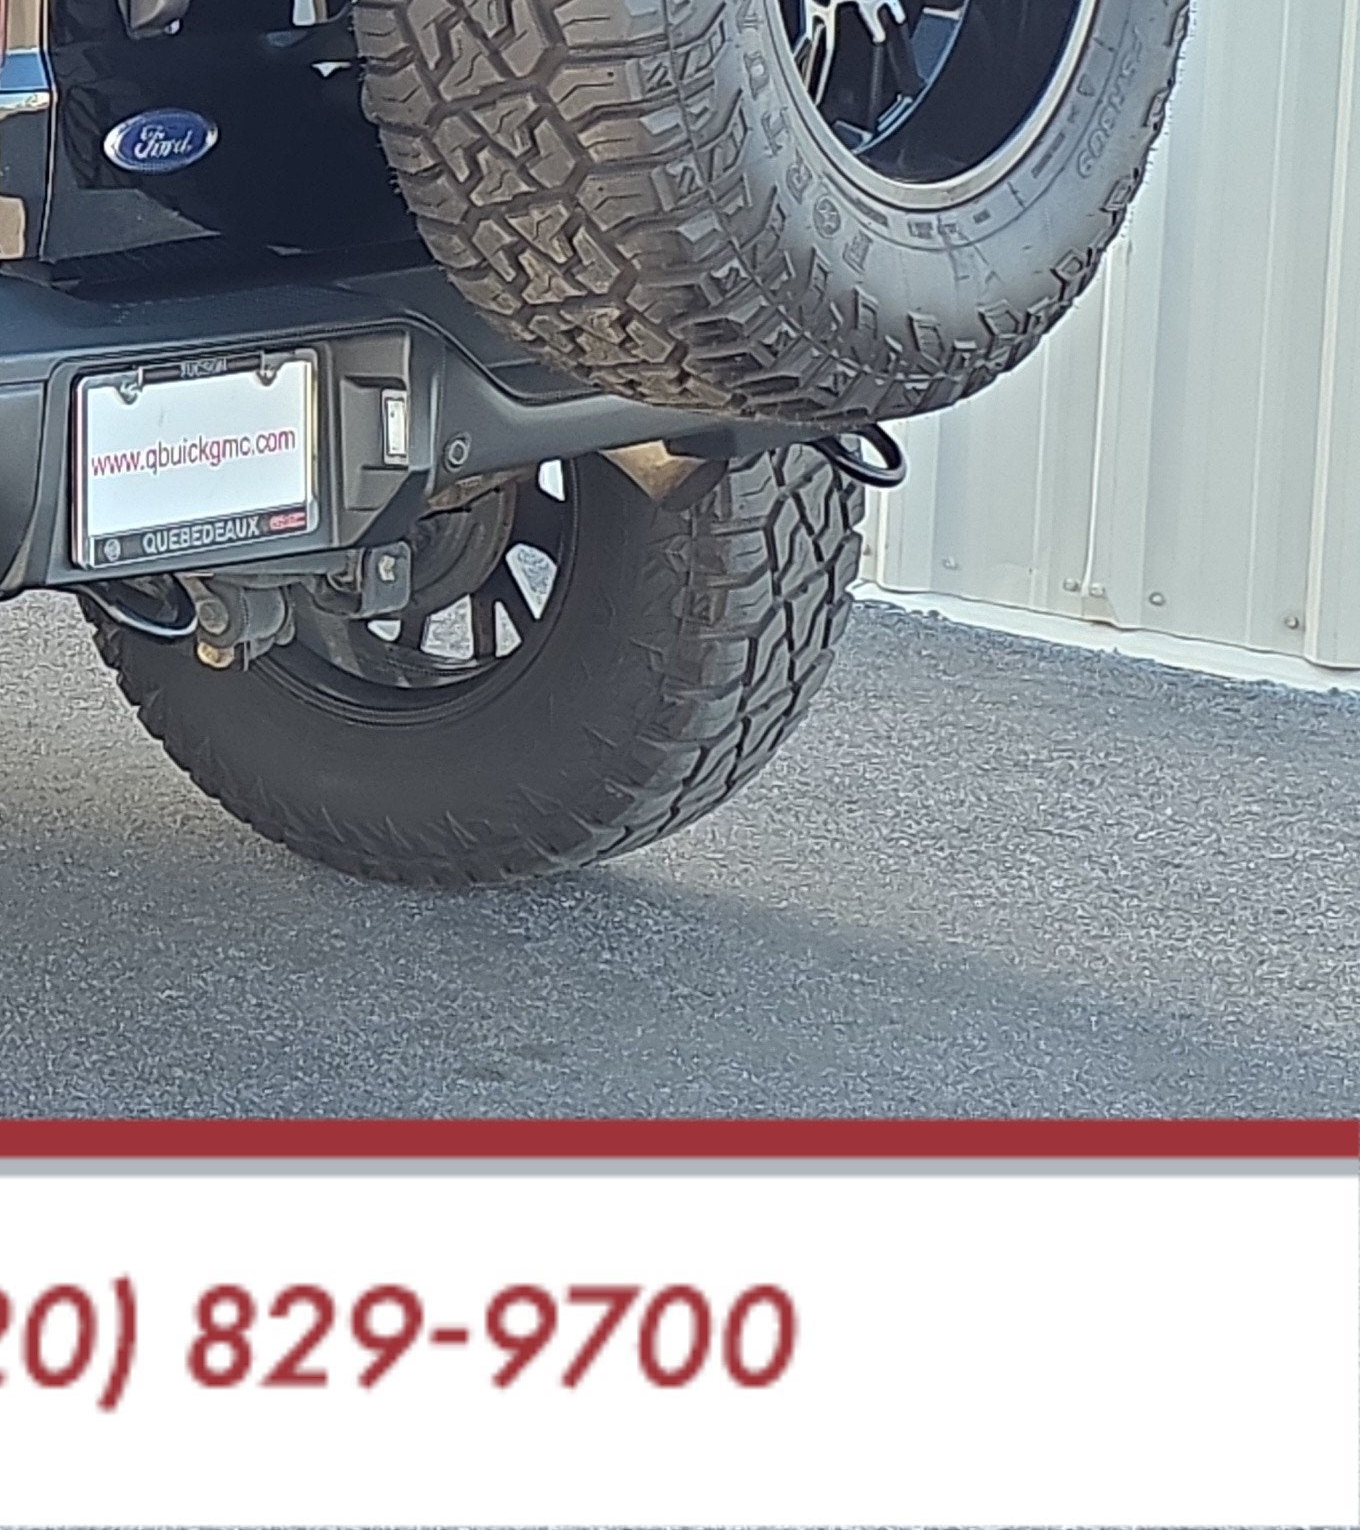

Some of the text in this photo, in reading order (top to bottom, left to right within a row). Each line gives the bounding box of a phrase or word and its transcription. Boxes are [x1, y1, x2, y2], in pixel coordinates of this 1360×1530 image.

[134, 124, 193, 160] Ford
[91, 429, 296, 476] www.qbuickgmc.com
[141, 516, 261, 554] QUEBEDEAUX
